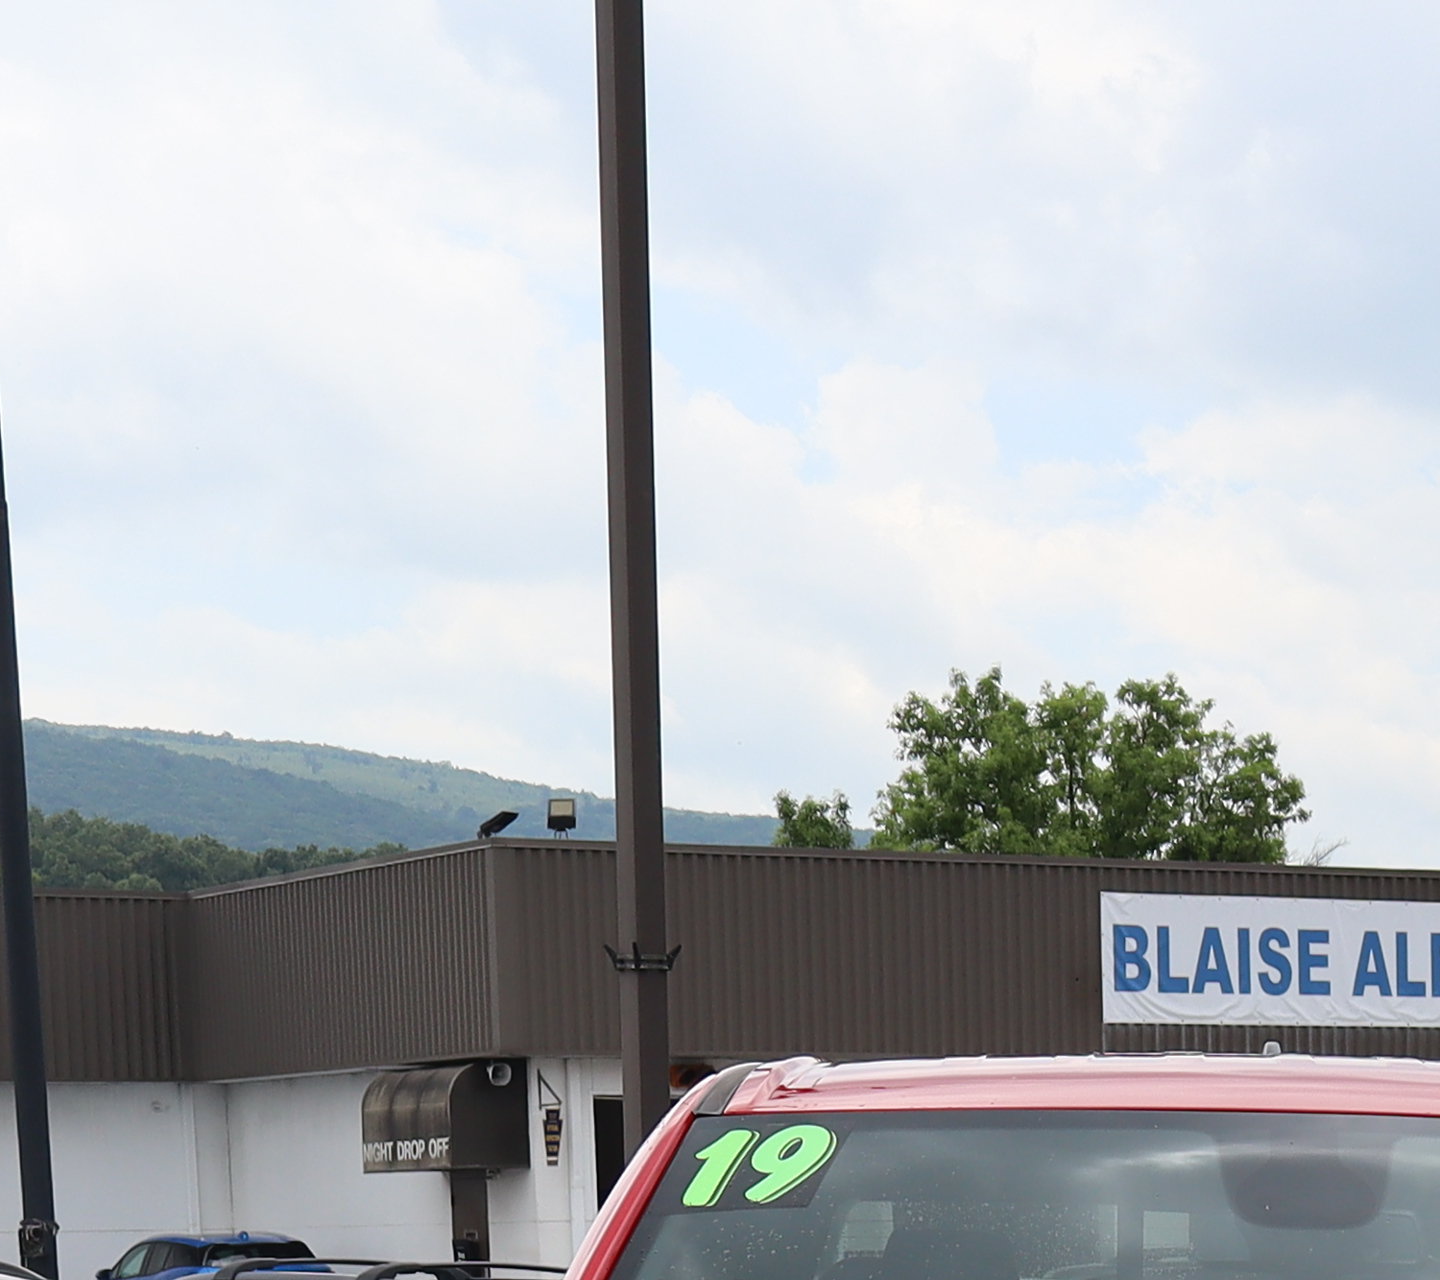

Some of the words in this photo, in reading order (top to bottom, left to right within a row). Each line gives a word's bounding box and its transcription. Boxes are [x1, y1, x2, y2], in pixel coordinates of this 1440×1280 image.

[1113, 924, 1331, 996] BLAISE
[363, 1141, 394, 1162] NIGHT
[397, 1138, 425, 1160] DROP
[429, 1136, 449, 1159] OFF
[682, 1123, 838, 1207] 19
